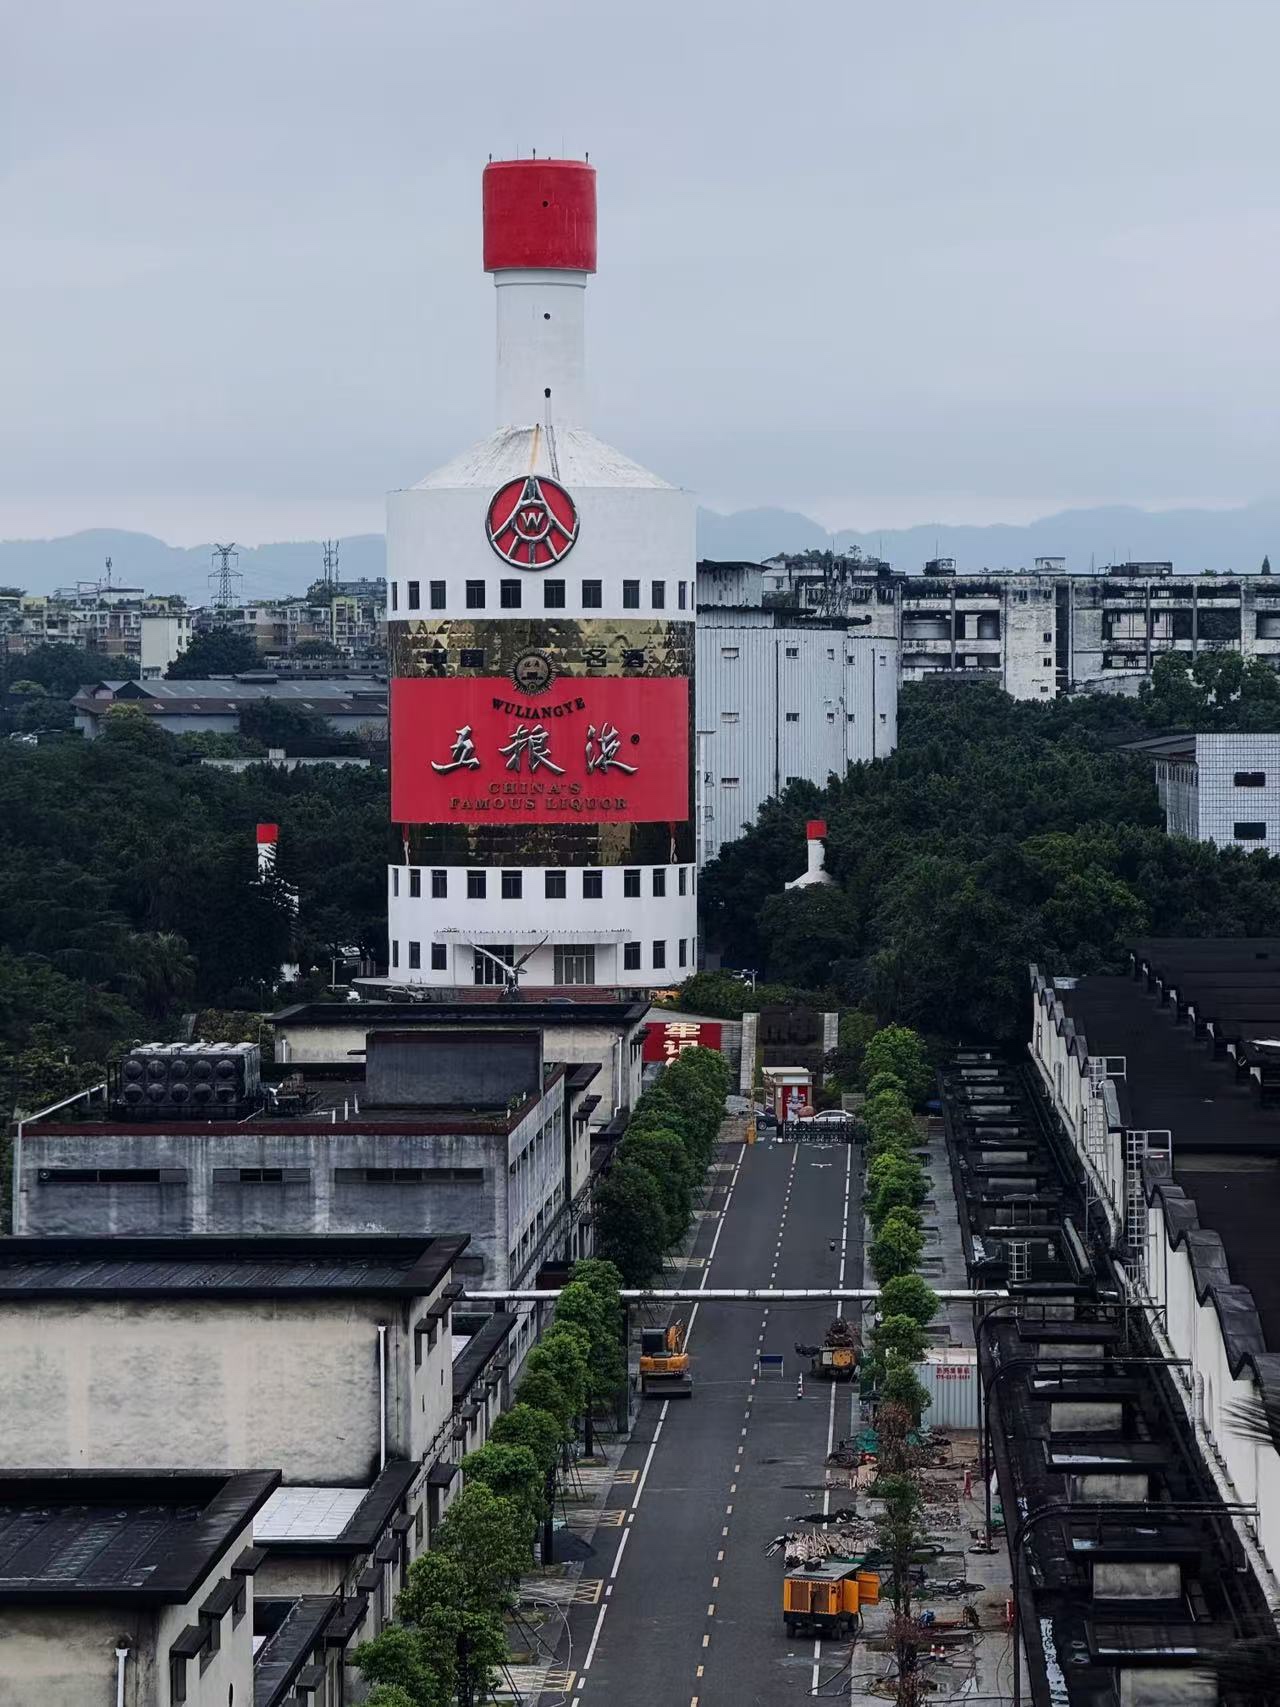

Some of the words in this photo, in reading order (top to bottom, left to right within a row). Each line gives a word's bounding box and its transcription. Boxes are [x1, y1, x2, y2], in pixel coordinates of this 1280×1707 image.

[519, 512, 545, 531] W
[492, 697, 586, 719] WULIANGYE
[431, 723, 639, 775] 五粮液
[488, 782, 582, 795] CHINA'S
[449, 797, 536, 810] FAMOUS
[545, 797, 628, 811] LIQUOR
